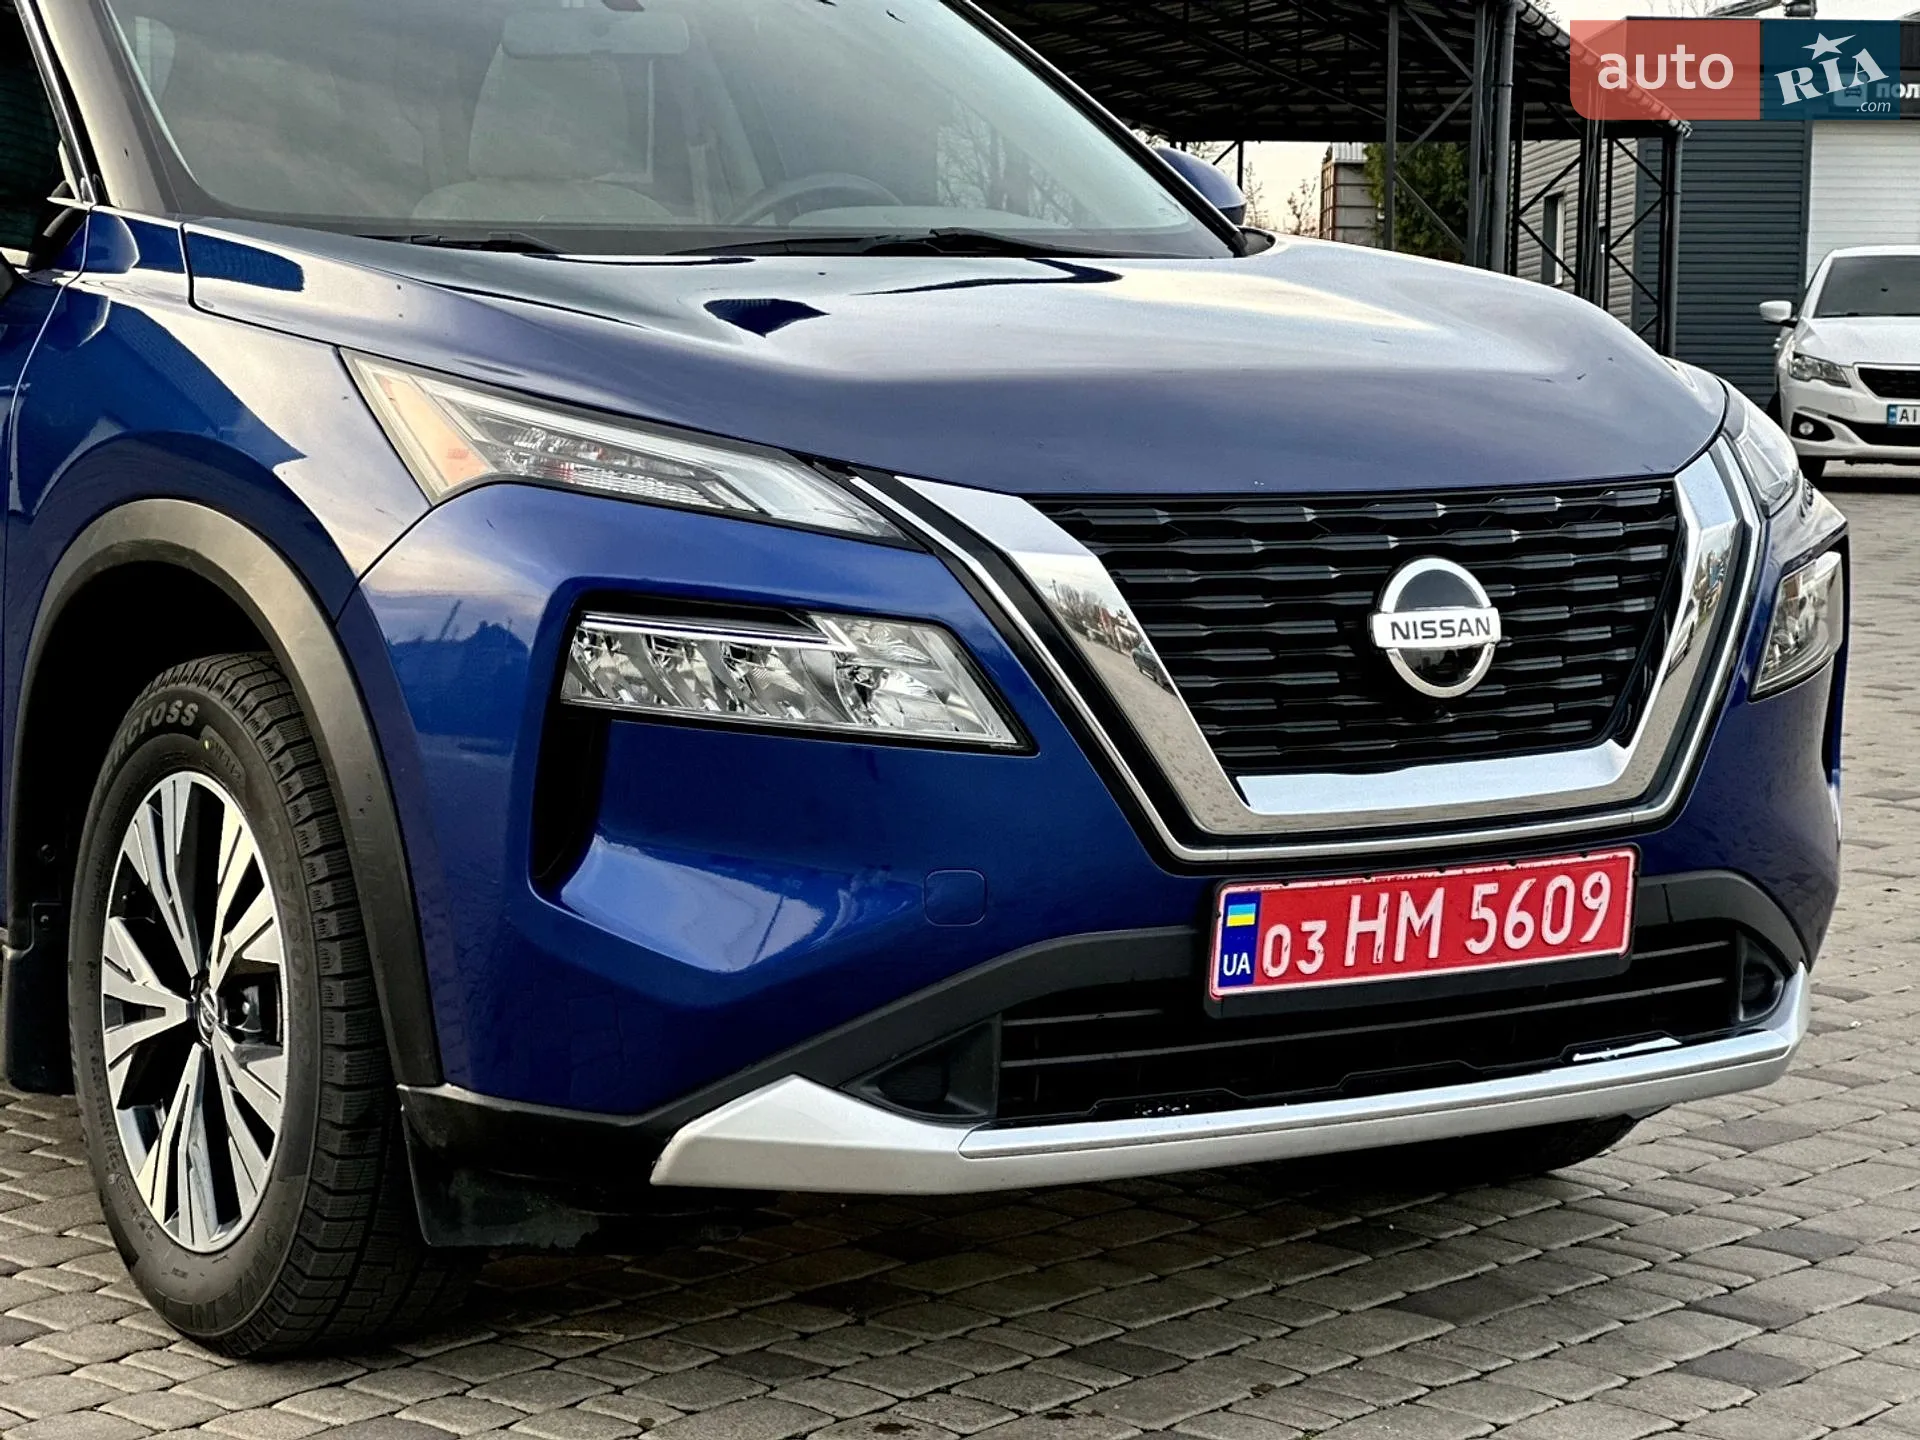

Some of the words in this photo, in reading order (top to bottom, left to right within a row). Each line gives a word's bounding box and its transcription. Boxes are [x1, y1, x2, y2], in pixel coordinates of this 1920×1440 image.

[1390, 616, 1491, 640] NISSAN
[1262, 920, 1328, 978] 03
[1344, 887, 1444, 968] HM
[1464, 871, 1612, 956] 5609
[1223, 953, 1251, 976] UA
